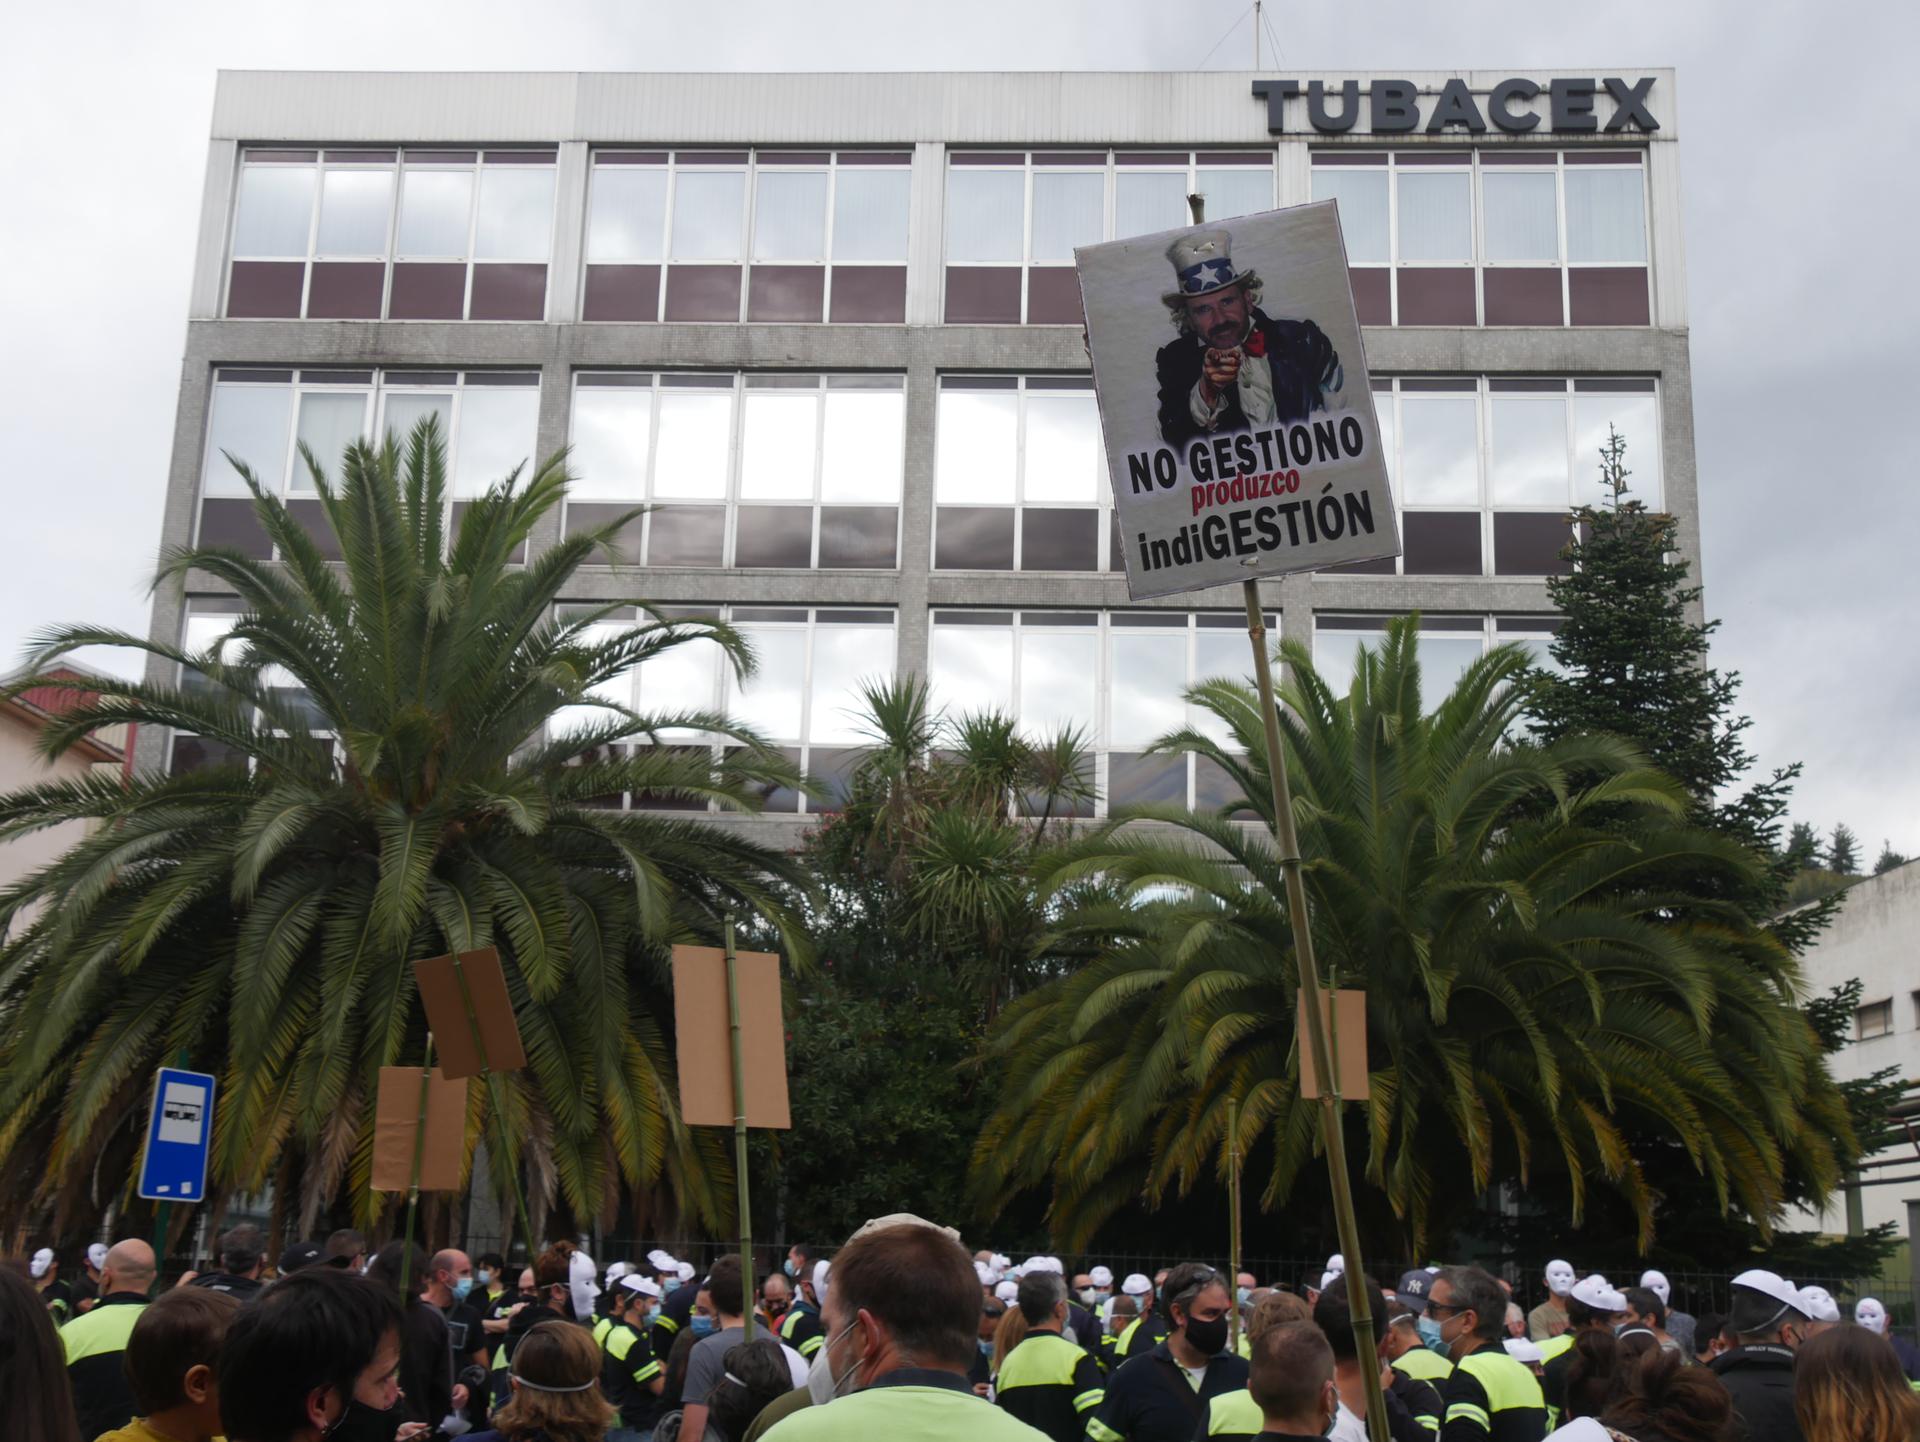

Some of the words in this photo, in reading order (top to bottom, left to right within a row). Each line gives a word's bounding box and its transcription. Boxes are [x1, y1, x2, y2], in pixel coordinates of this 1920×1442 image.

[1251, 77, 1660, 135] TUBACEX
[1128, 449, 1177, 494] NO
[1189, 416, 1363, 483] GESTIONO
[1191, 468, 1300, 516] produzco
[1138, 482, 1375, 571] indiGESTIÓN
